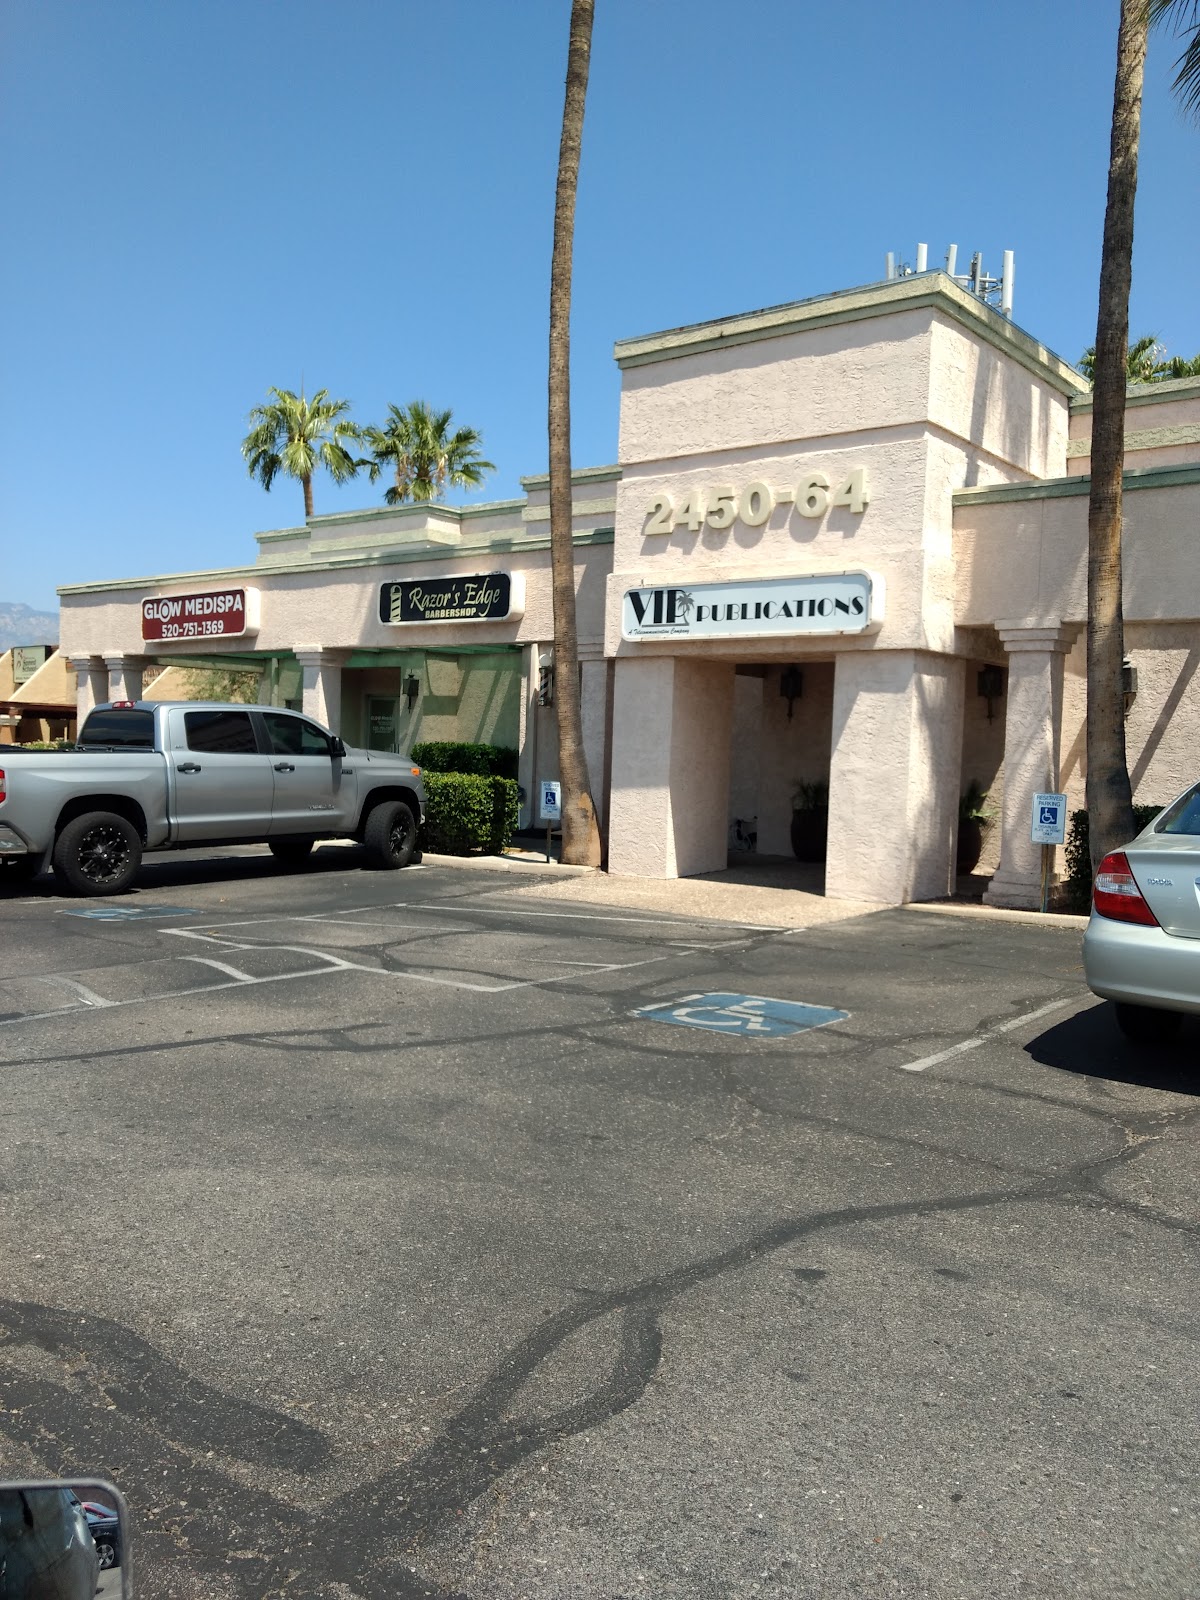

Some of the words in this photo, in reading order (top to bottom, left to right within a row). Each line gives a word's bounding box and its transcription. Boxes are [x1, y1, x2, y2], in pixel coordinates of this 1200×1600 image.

[644, 468, 870, 536] 2450-64
[144, 600, 182, 622] GLOW
[185, 594, 243, 616] MEDISPA
[409, 584, 460, 611] Razor's
[464, 577, 500, 617] Edge
[628, 589, 688, 626] VIP
[696, 595, 864, 622] PUBLICATIONS
[425, 607, 477, 618] BARBERSHOP
[162, 620, 224, 637] 520-751-1369
[670, 627, 690, 635] Company
